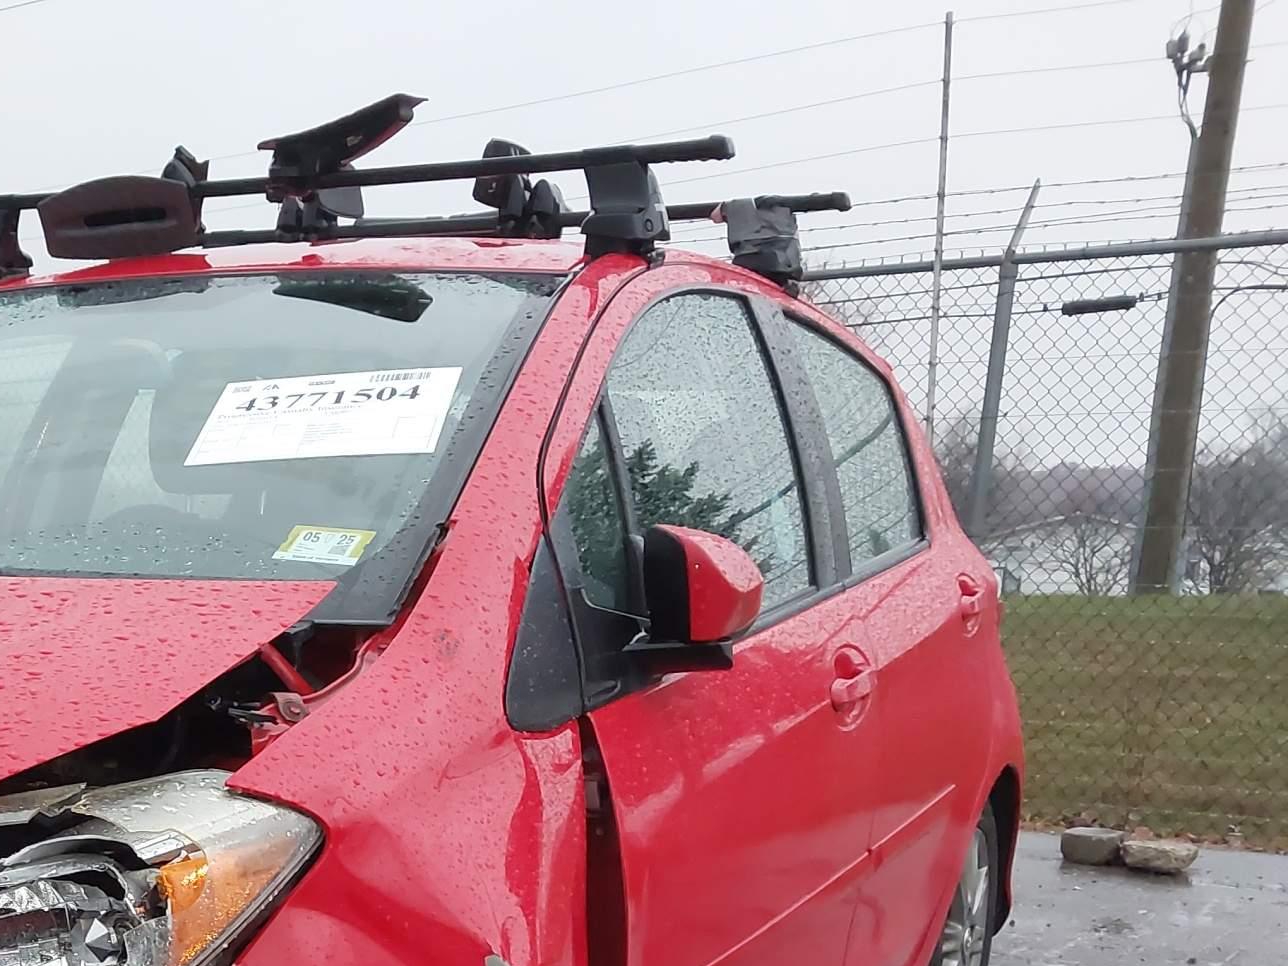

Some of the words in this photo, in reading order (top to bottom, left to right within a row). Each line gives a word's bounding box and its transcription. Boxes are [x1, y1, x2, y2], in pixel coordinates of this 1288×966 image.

[235, 384, 420, 411] 43771504
[303, 531, 322, 543] 05
[337, 534, 357, 545] 25
